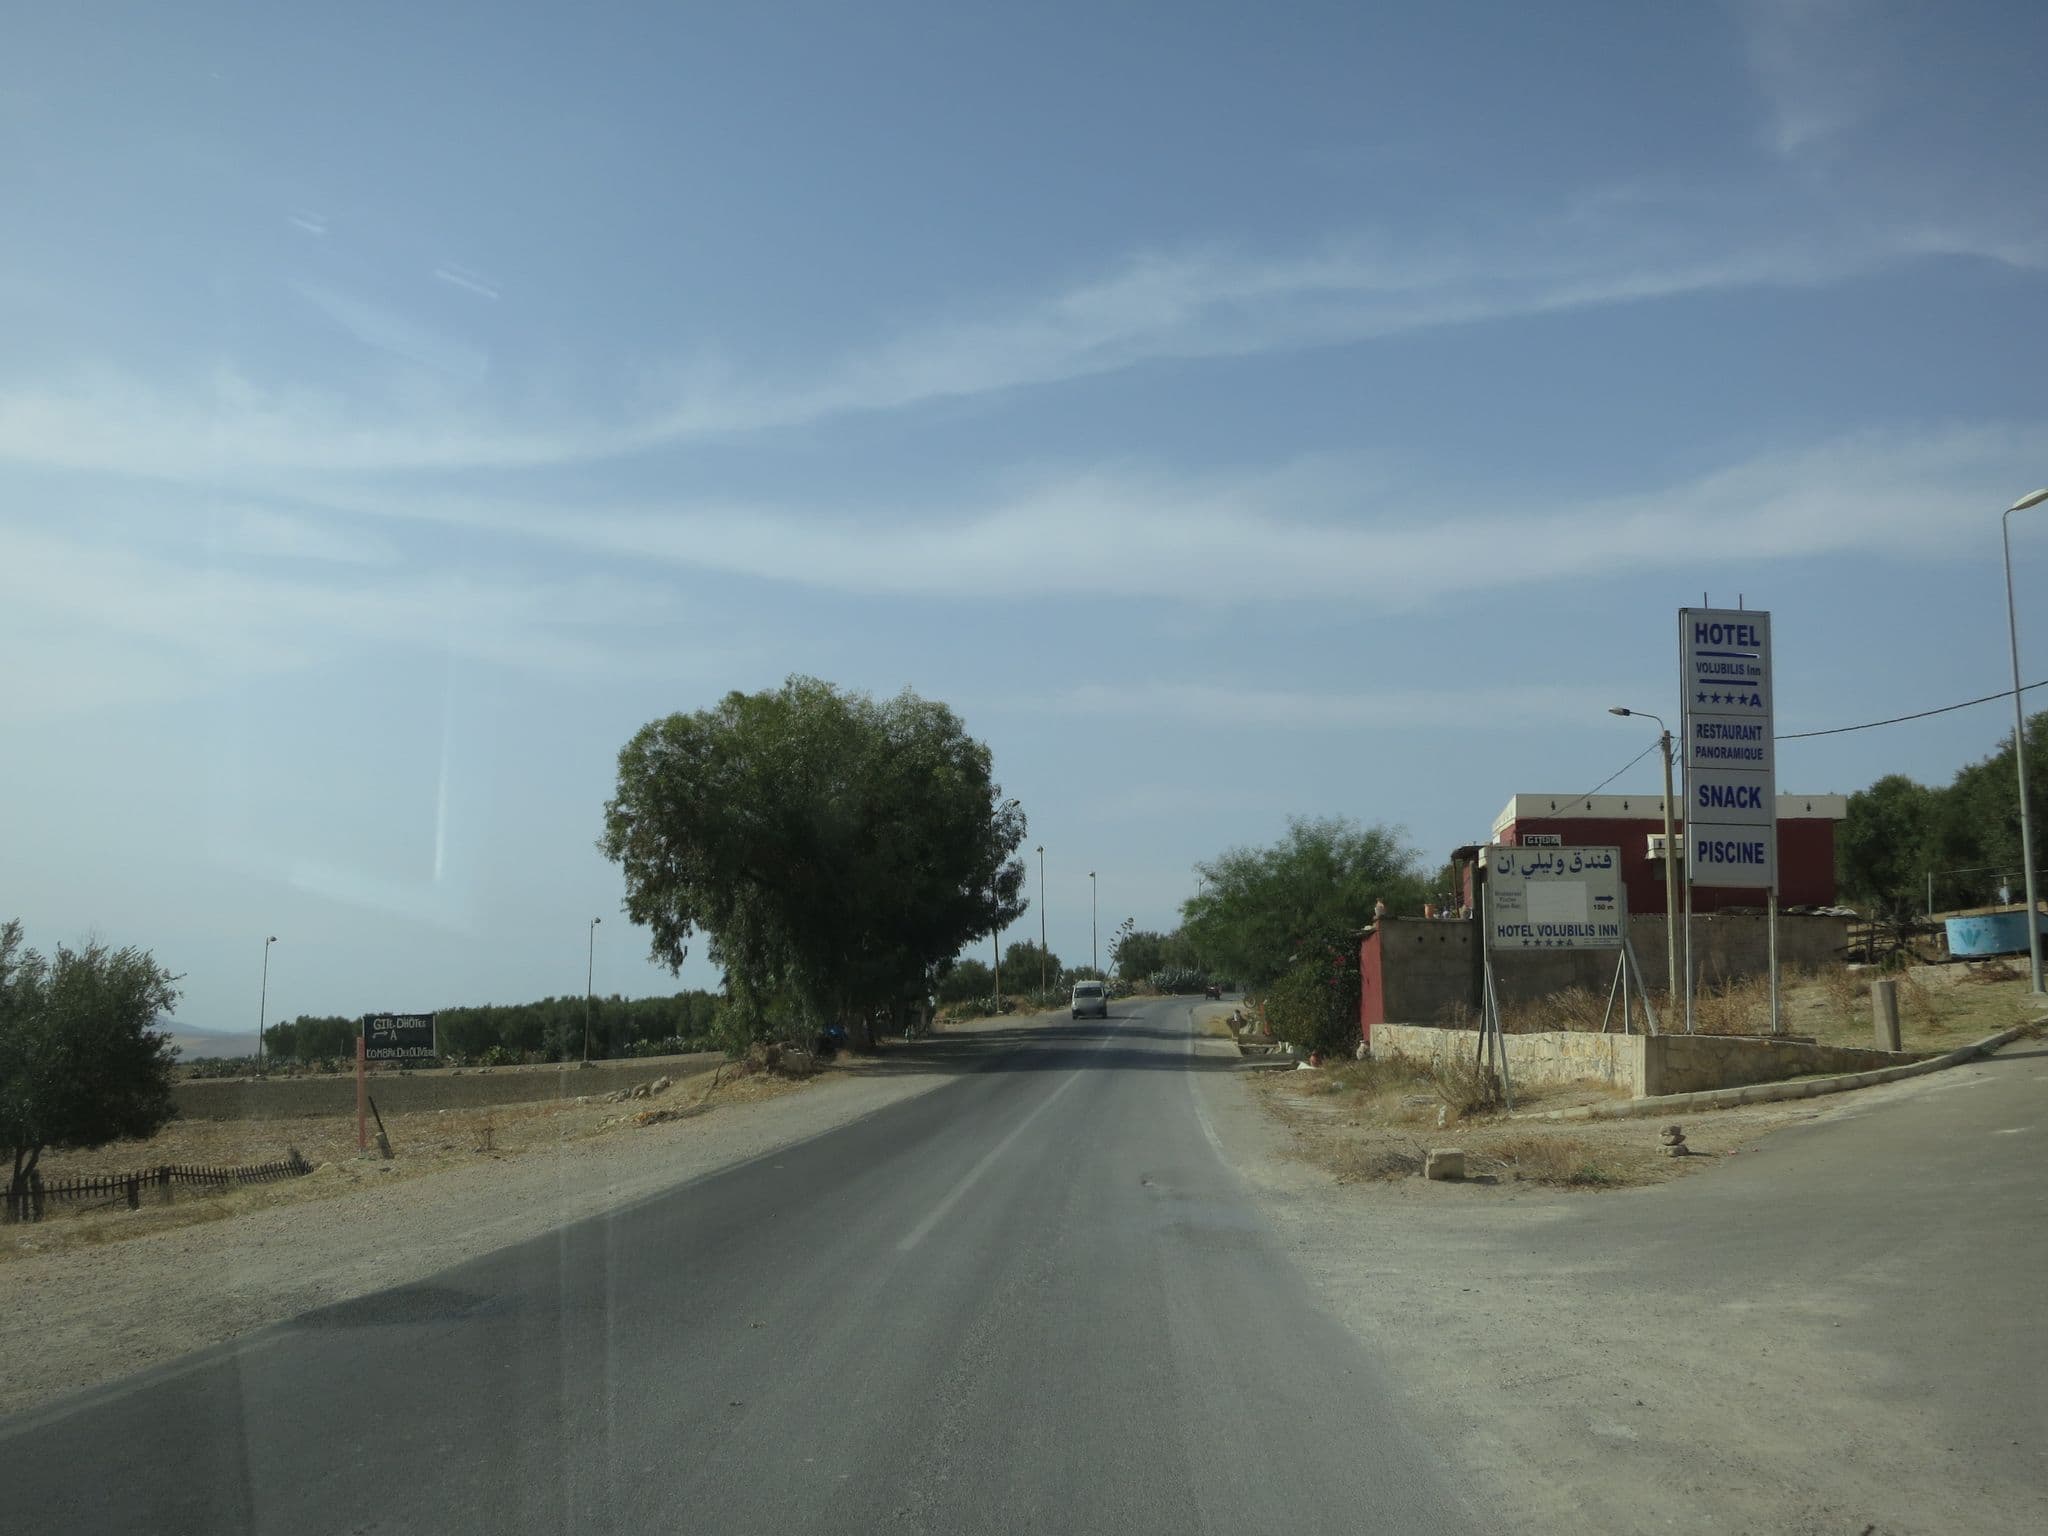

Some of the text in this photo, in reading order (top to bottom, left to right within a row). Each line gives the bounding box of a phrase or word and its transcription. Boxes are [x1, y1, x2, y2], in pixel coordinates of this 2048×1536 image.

[1695, 622, 1760, 647] HOTEL
[1696, 662, 1761, 676] VOLUBILIS Inn
[1749, 693, 1762, 708] A
[1696, 723, 1762, 741] RESTAURANT
[1695, 746, 1764, 761] PANORAMIQUE
[1698, 784, 1762, 809] SNACK
[1698, 840, 1765, 865] PISCINE
[1497, 850, 1612, 880] فندق وليلي إن
[1497, 924, 1618, 938] HOTEL VOLUBILIS INN
[390, 1030, 398, 1041] A
